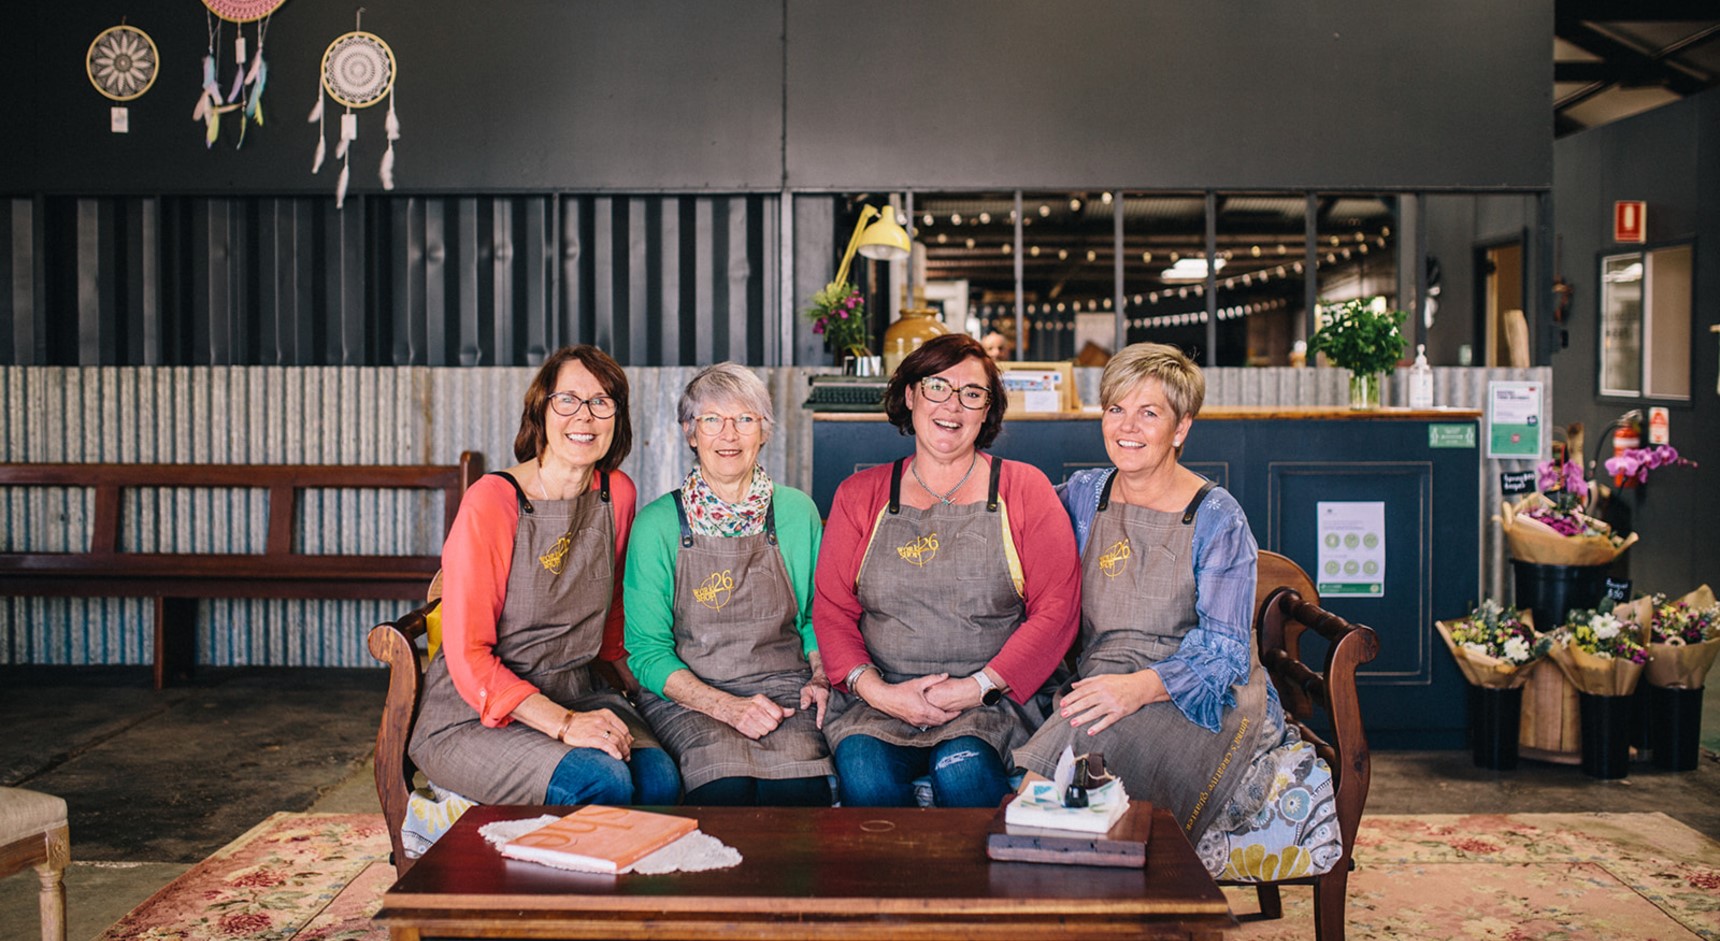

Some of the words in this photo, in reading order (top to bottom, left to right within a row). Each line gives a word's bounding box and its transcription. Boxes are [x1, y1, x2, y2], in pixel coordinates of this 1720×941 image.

[918, 533, 939, 552] 26
[1114, 538, 1130, 560] 26
[711, 569, 734, 592] 26
